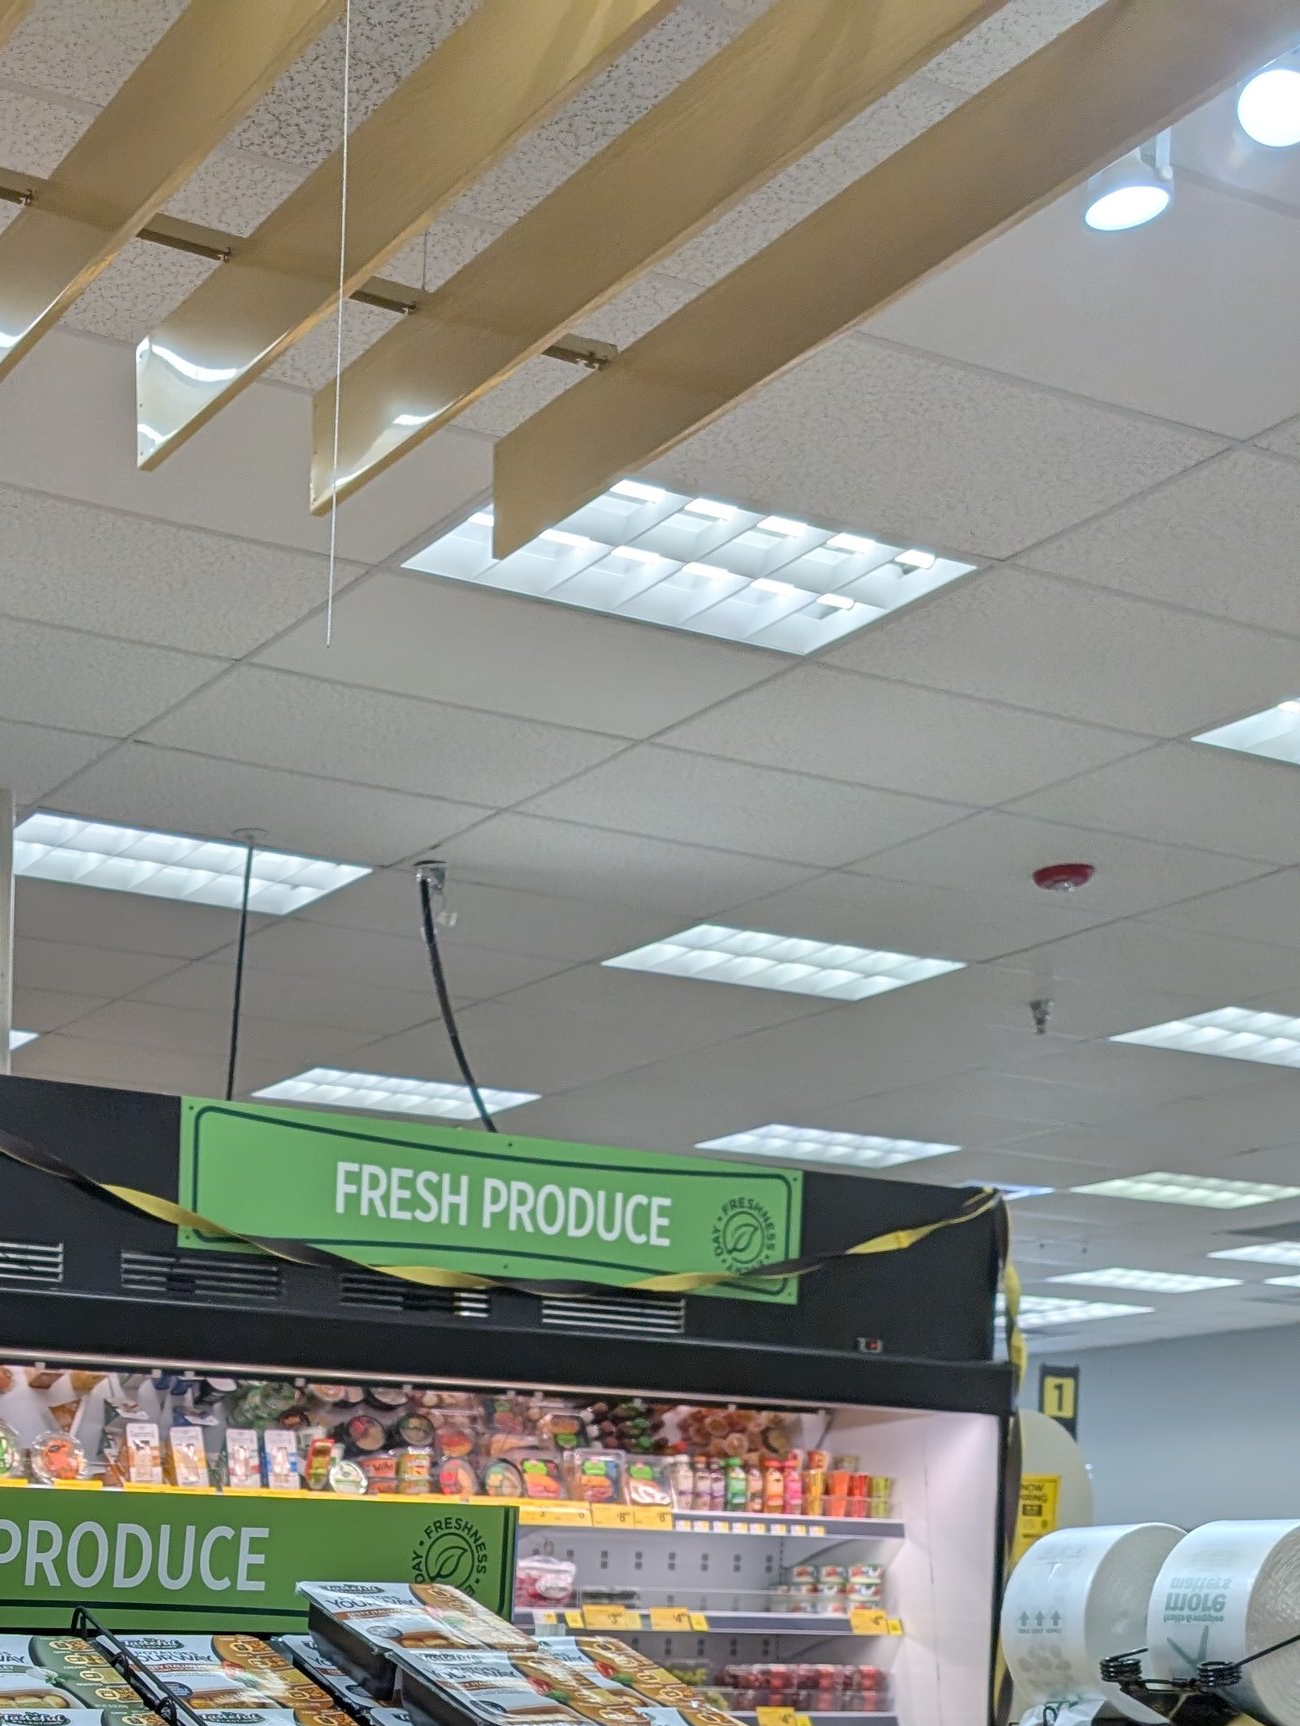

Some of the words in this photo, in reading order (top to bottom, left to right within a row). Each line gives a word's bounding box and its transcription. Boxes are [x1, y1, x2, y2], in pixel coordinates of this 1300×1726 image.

[335, 1161, 470, 1226] FRESH
[482, 1177, 672, 1247] PRODUCE
[721, 1197, 776, 1251] FRESHNESS
[711, 1225, 724, 1257] DAY
[1053, 1382, 1064, 1412] 1
[412, 1550, 426, 1584] DAY
[424, 1517, 487, 1575] FRESHNESS
